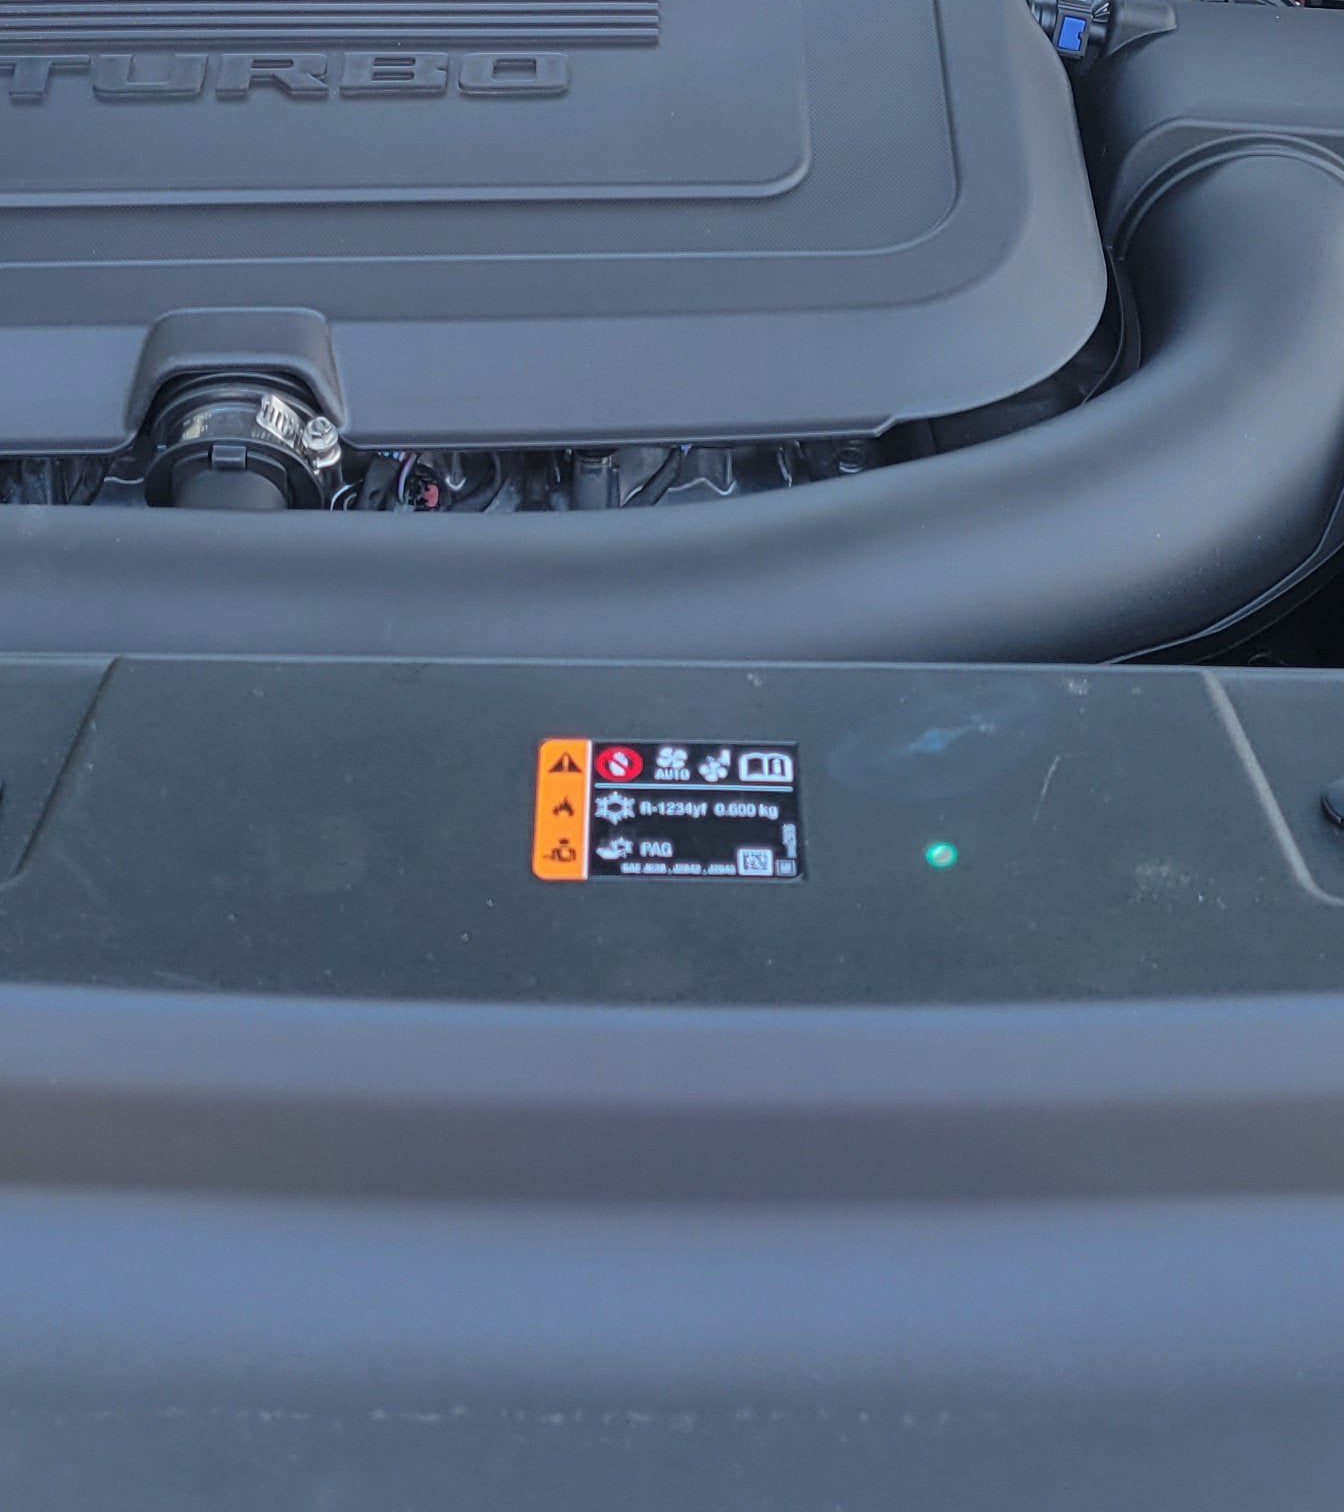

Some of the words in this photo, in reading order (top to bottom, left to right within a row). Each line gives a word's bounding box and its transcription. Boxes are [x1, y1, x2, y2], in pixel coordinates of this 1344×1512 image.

[654, 768, 690, 781] AUTO
[639, 801, 708, 819] R-1234yf
[713, 802, 756, 817] 0.600
[758, 803, 779, 820] kg
[640, 841, 673, 858] PAG
